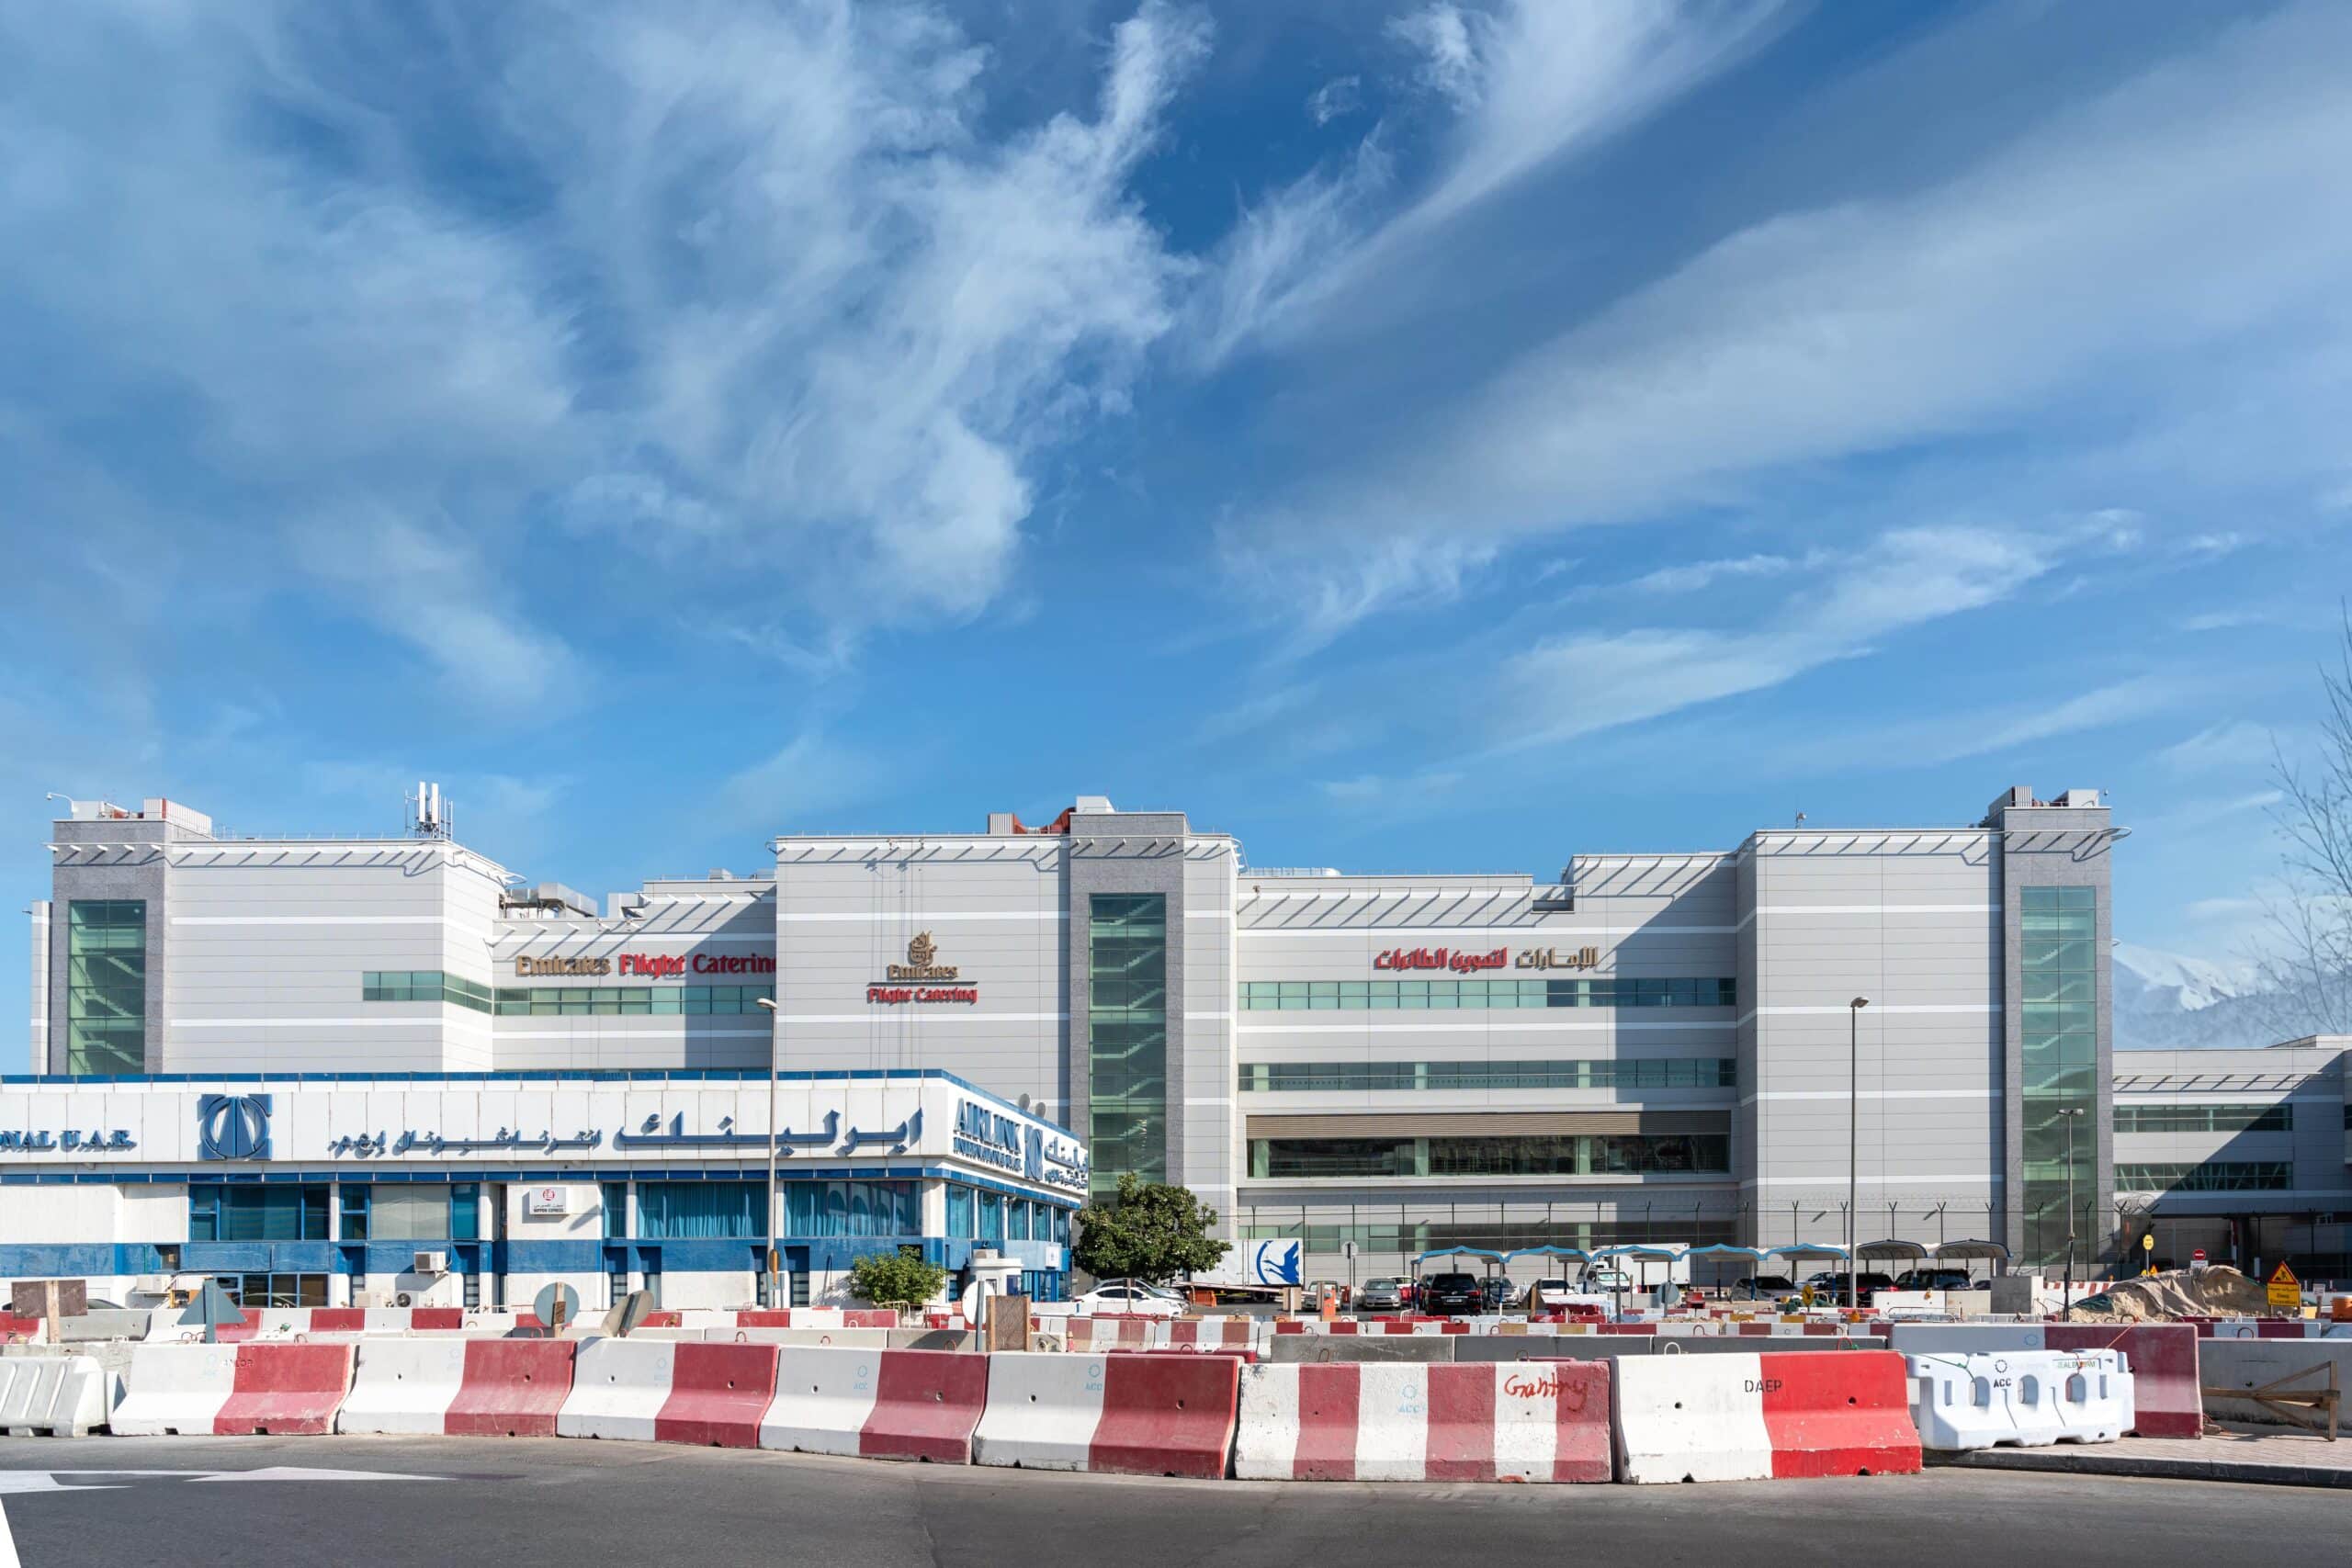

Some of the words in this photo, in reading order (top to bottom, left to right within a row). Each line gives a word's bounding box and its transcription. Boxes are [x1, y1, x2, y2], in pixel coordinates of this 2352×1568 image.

[515, 954, 611, 976] Emirates
[618, 953, 685, 980] Flight
[1374, 947, 1449, 972] الطائرات
[1449, 946, 1508, 975] لتموين
[1515, 946, 1599, 972] الإمارات
[887, 964, 958, 980] Emirates
[867, 987, 912, 1006] Flight
[914, 987, 978, 1006] Catering
[953, 1098, 1022, 1155] AIRLINK
[1745, 1380, 1782, 1393] DAEP
[1993, 1378, 2012, 1389] ACC
